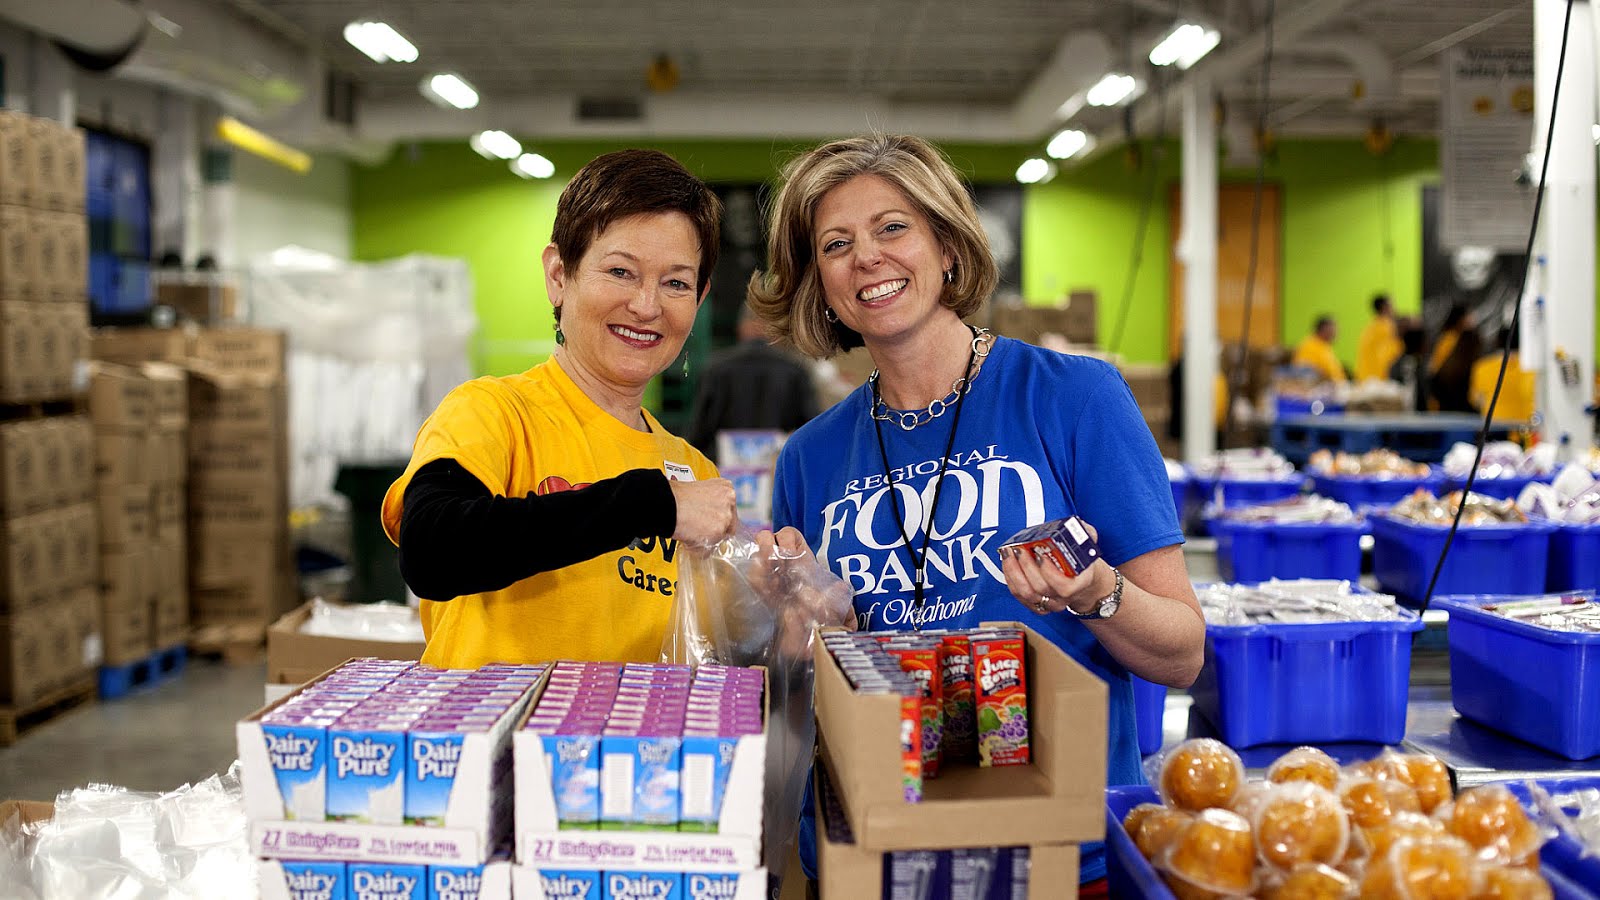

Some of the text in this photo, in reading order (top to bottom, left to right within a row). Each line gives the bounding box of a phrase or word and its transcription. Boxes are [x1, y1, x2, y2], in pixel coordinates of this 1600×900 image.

[845, 444, 1008, 496] REGIONAL
[816, 459, 1046, 572] FOOD
[836, 530, 1008, 596] BANK
[617, 555, 678, 597] Care
[859, 594, 977, 631] of Oklahoma
[333, 737, 396, 761] Dairy
[413, 739, 462, 762] Dair
[338, 757, 390, 780] Pure
[418, 759, 458, 781] Pur
[354, 871, 417, 895] Dairy
[434, 870, 481, 894] Dair
[610, 874, 674, 898] Dairy
[690, 874, 737, 898] Dair
